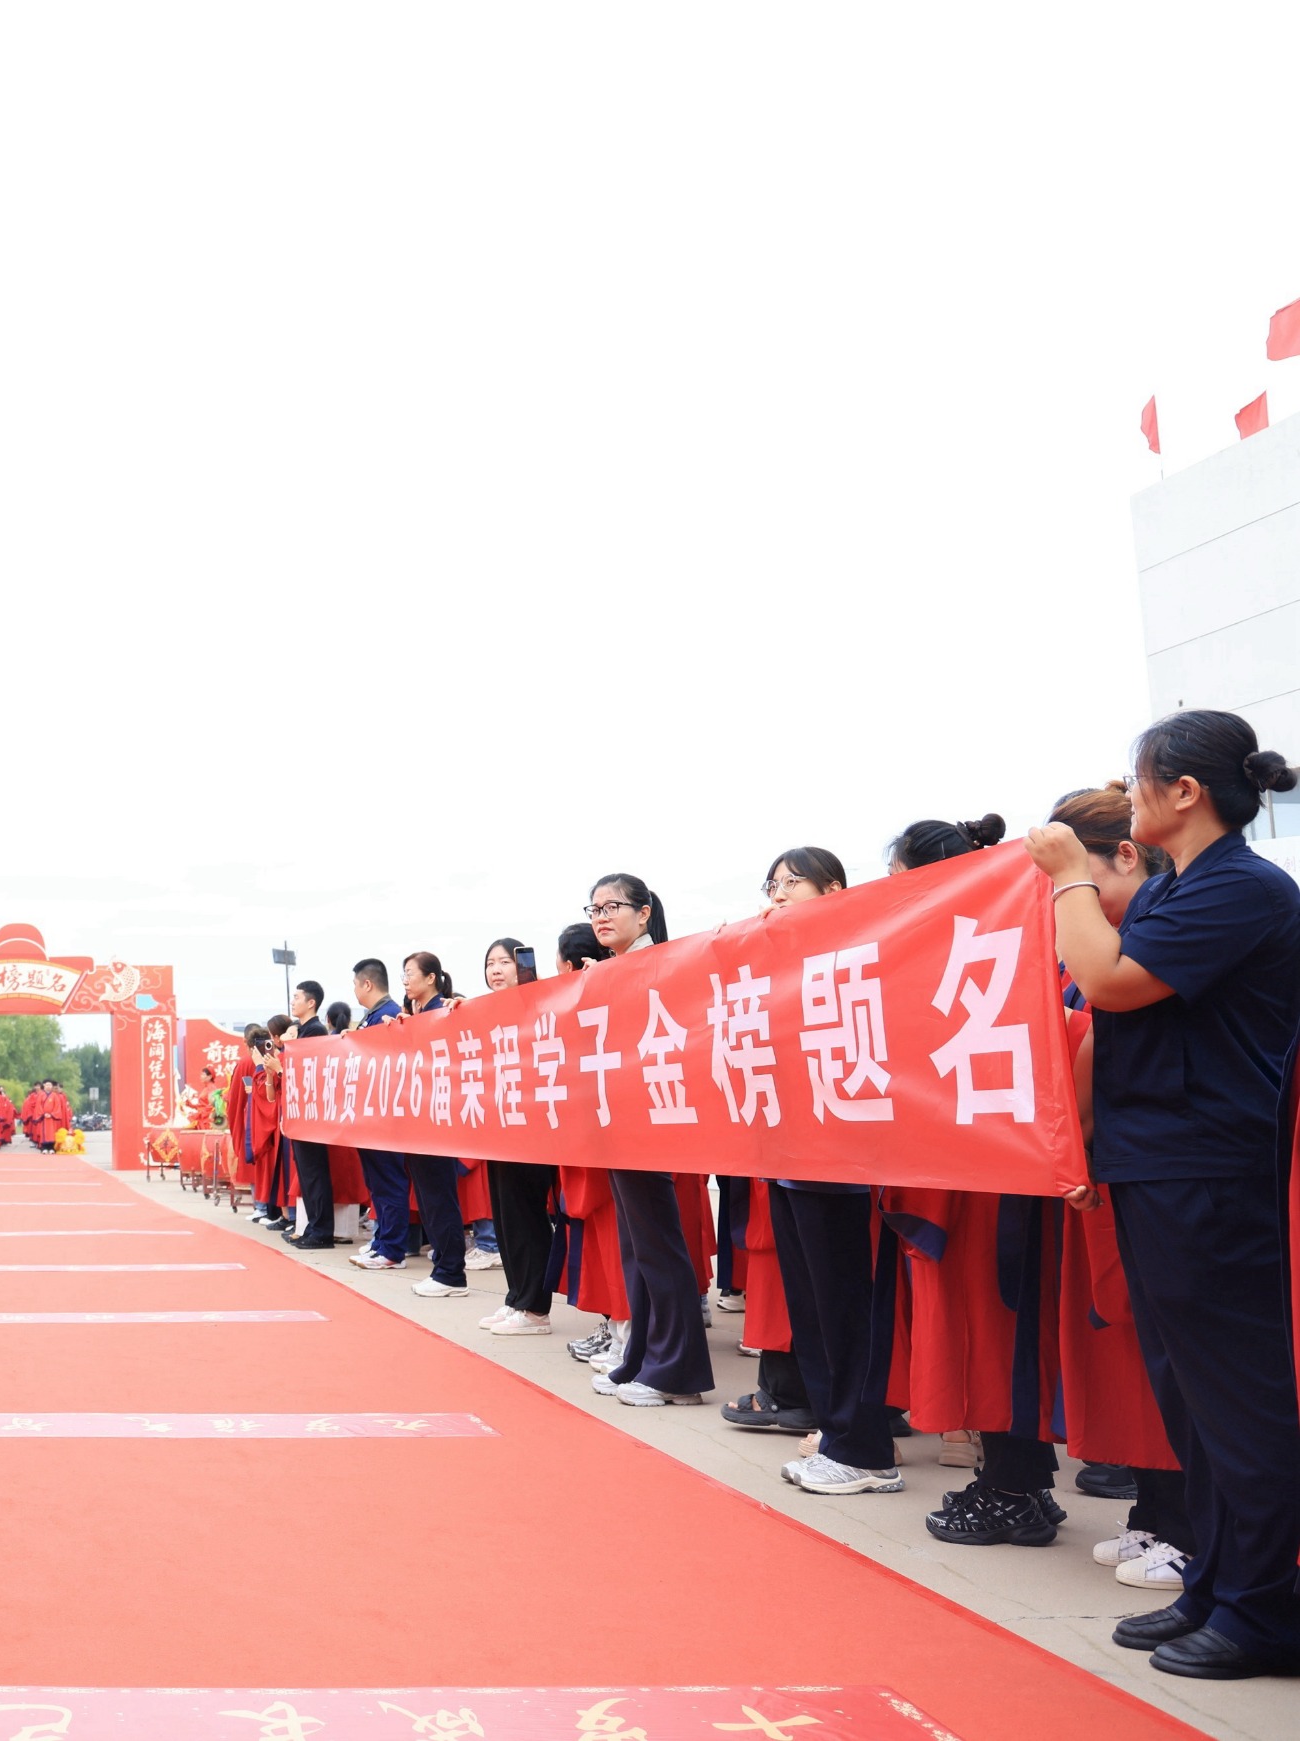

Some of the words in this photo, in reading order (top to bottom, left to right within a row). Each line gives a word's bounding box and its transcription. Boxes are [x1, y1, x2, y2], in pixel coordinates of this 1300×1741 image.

[146, 1020, 168, 1119] 海阔凭鱼跃
[202, 1040, 241, 1063] 前程
[285, 916, 1035, 1129] 热烈祝贺2026届荣程学子金榜题名
